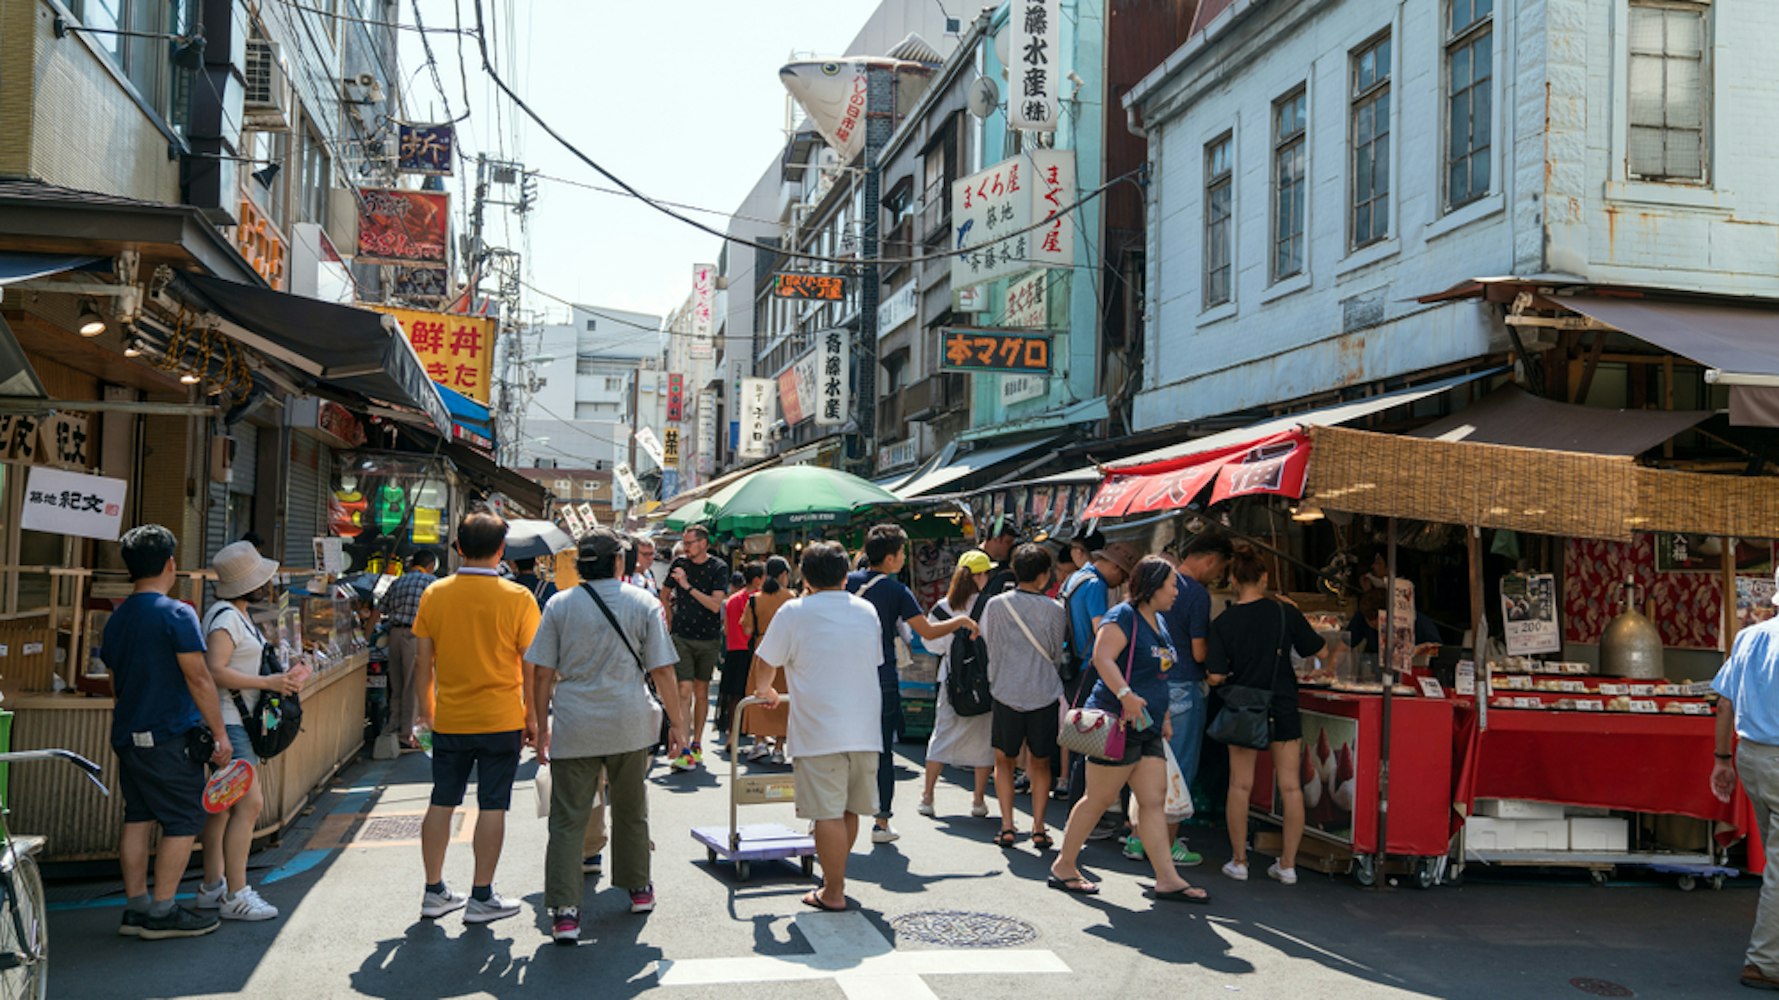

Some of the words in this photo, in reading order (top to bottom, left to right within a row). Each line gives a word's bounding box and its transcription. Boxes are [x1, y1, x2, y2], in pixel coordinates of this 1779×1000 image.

[1021, 0, 1051, 123] 藤水産(株)
[400, 320, 483, 359] 鮮丼
[946, 333, 1048, 368] 本マグロ
